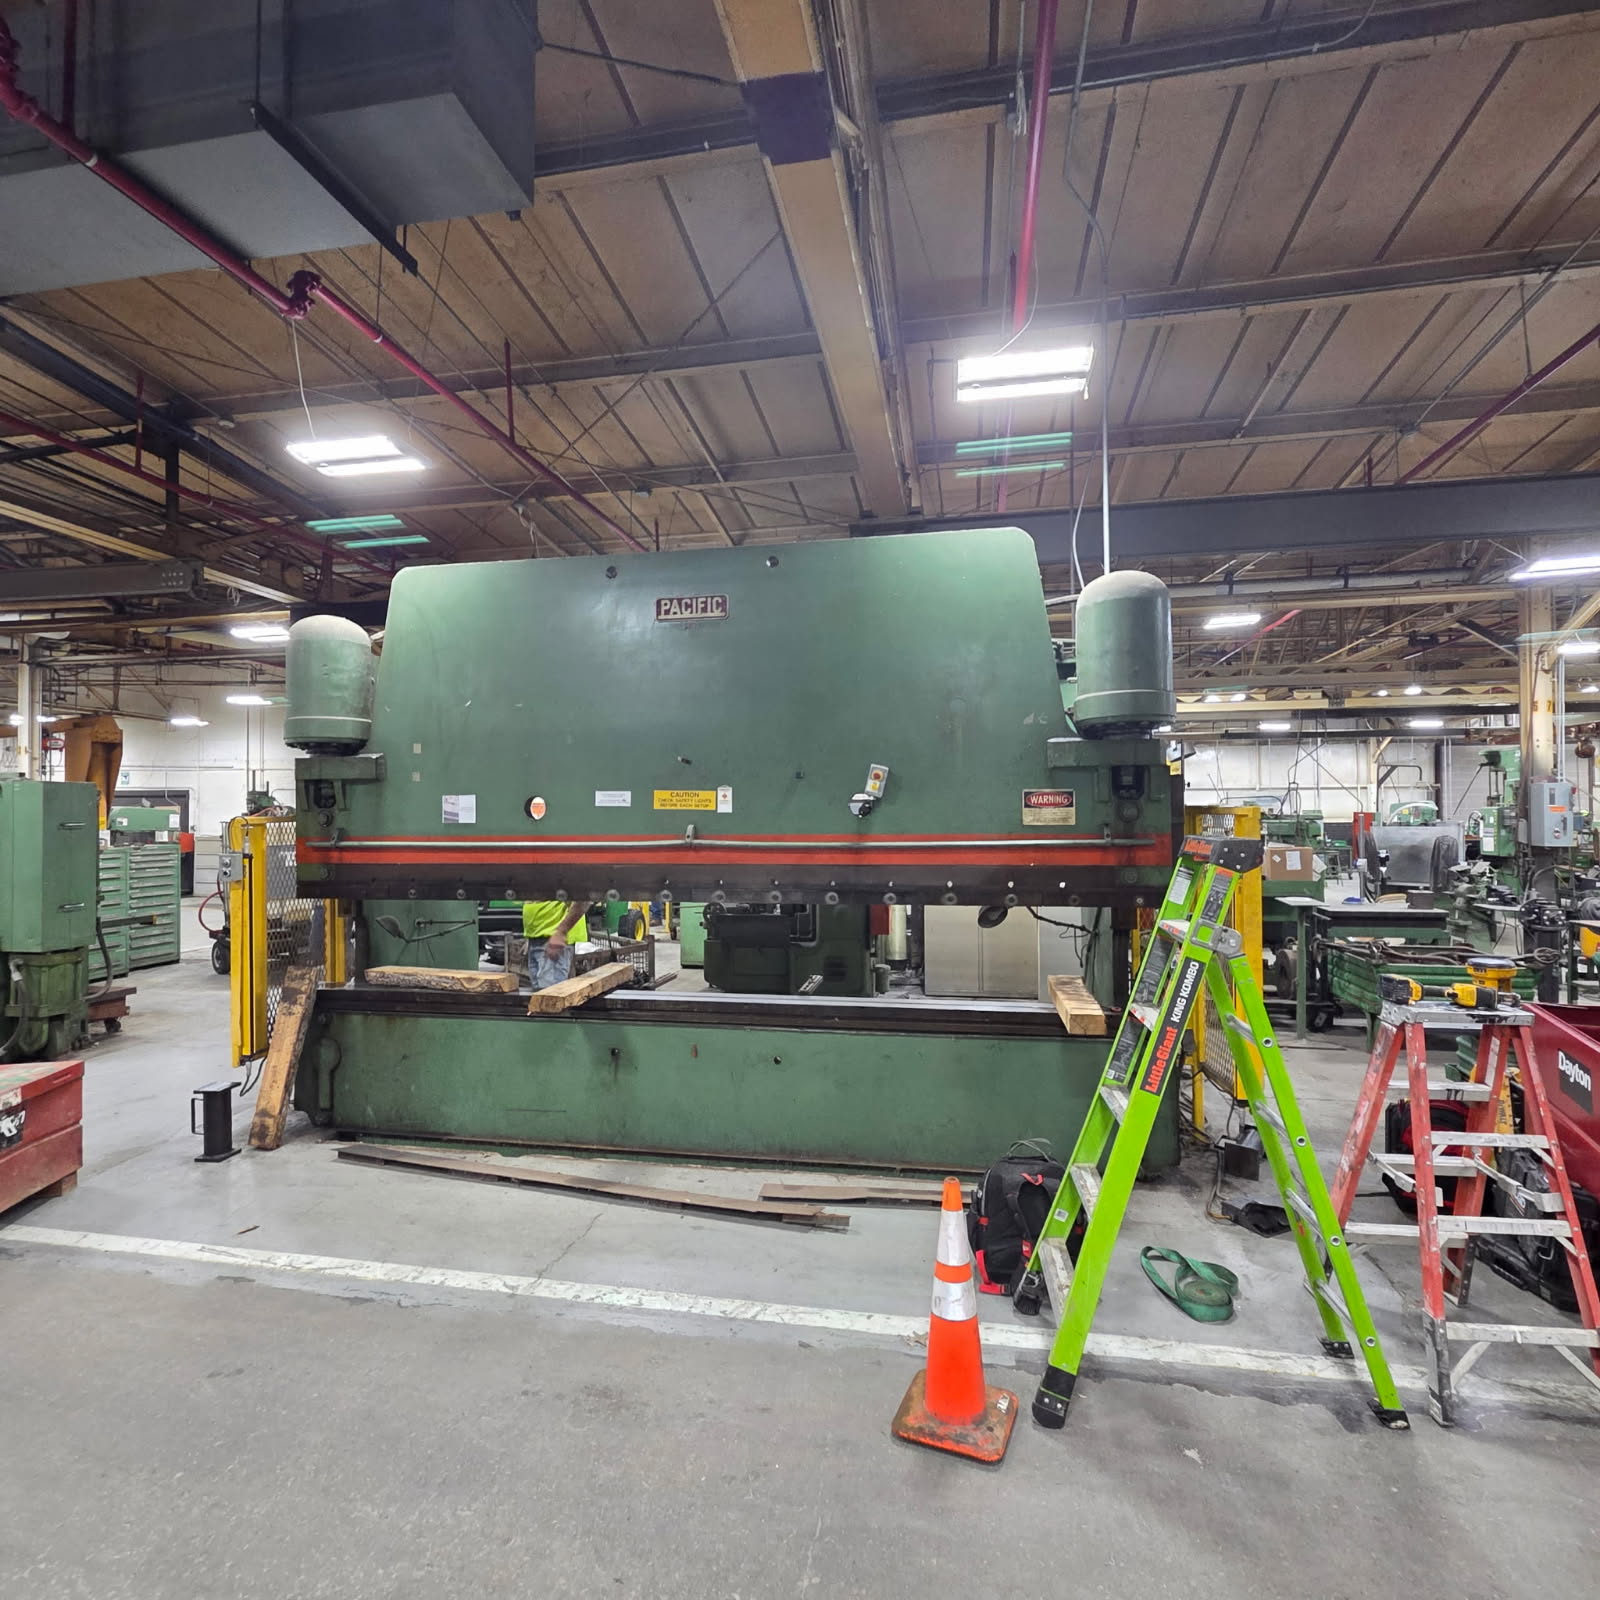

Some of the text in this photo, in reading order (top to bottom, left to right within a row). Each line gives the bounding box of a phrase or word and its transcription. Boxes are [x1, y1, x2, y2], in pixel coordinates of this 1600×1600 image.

[660, 597, 722, 616] PACIFIC
[1030, 794, 1068, 804] WARNING
[1171, 997, 1187, 1023] KING
[1180, 961, 1200, 998] KOMBO
[1558, 1050, 1592, 1091] Dayton
